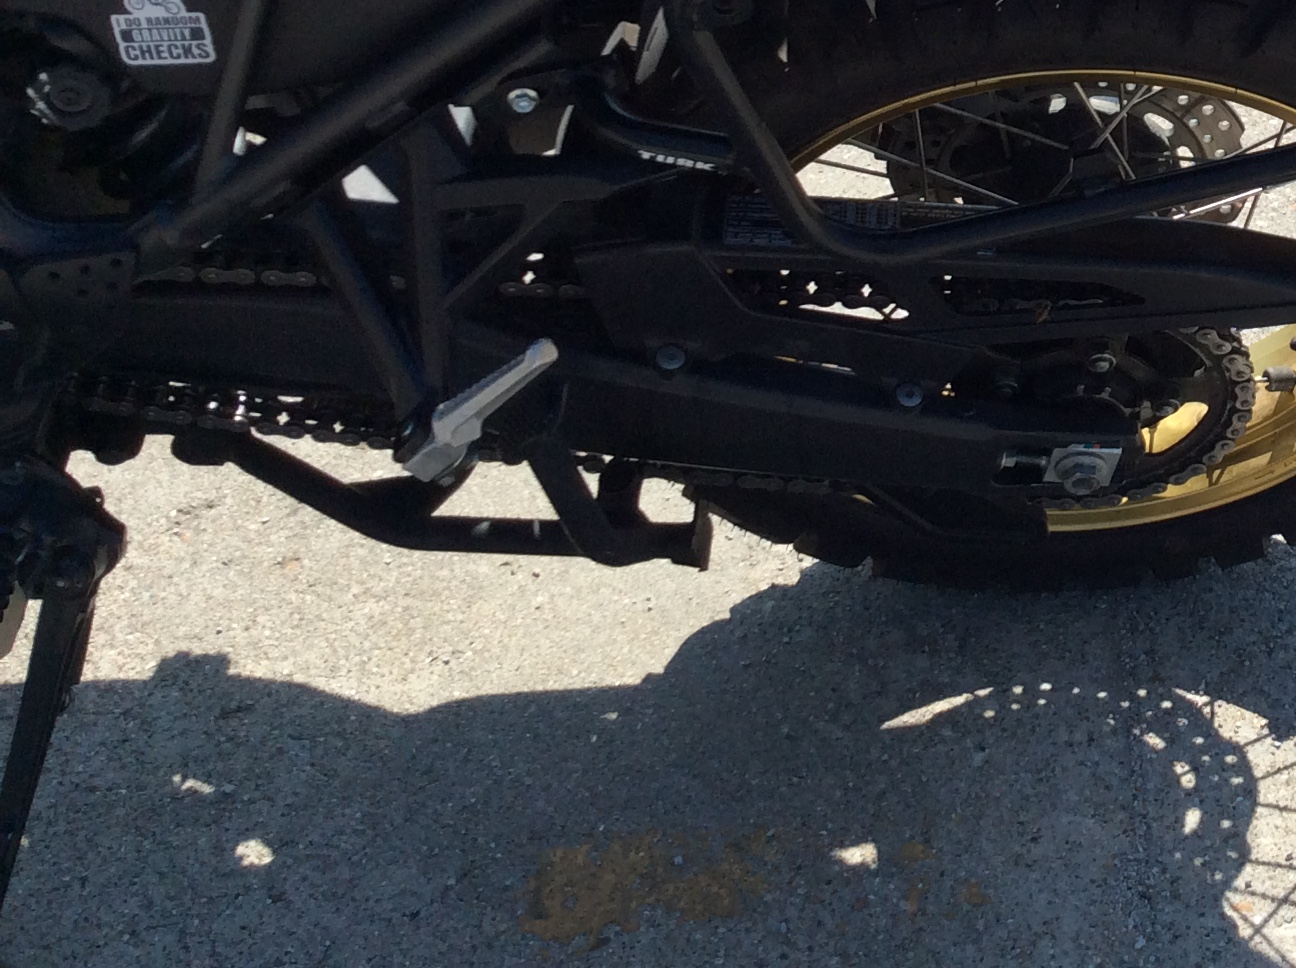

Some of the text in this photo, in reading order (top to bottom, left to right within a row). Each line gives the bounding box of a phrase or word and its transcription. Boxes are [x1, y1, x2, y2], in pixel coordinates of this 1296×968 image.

[124, 16, 142, 27] DO
[146, 15, 202, 27] RANDOM
[131, 28, 192, 42] GRAVITY
[123, 42, 210, 61] CHECKS
[636, 150, 717, 171] TUSK
